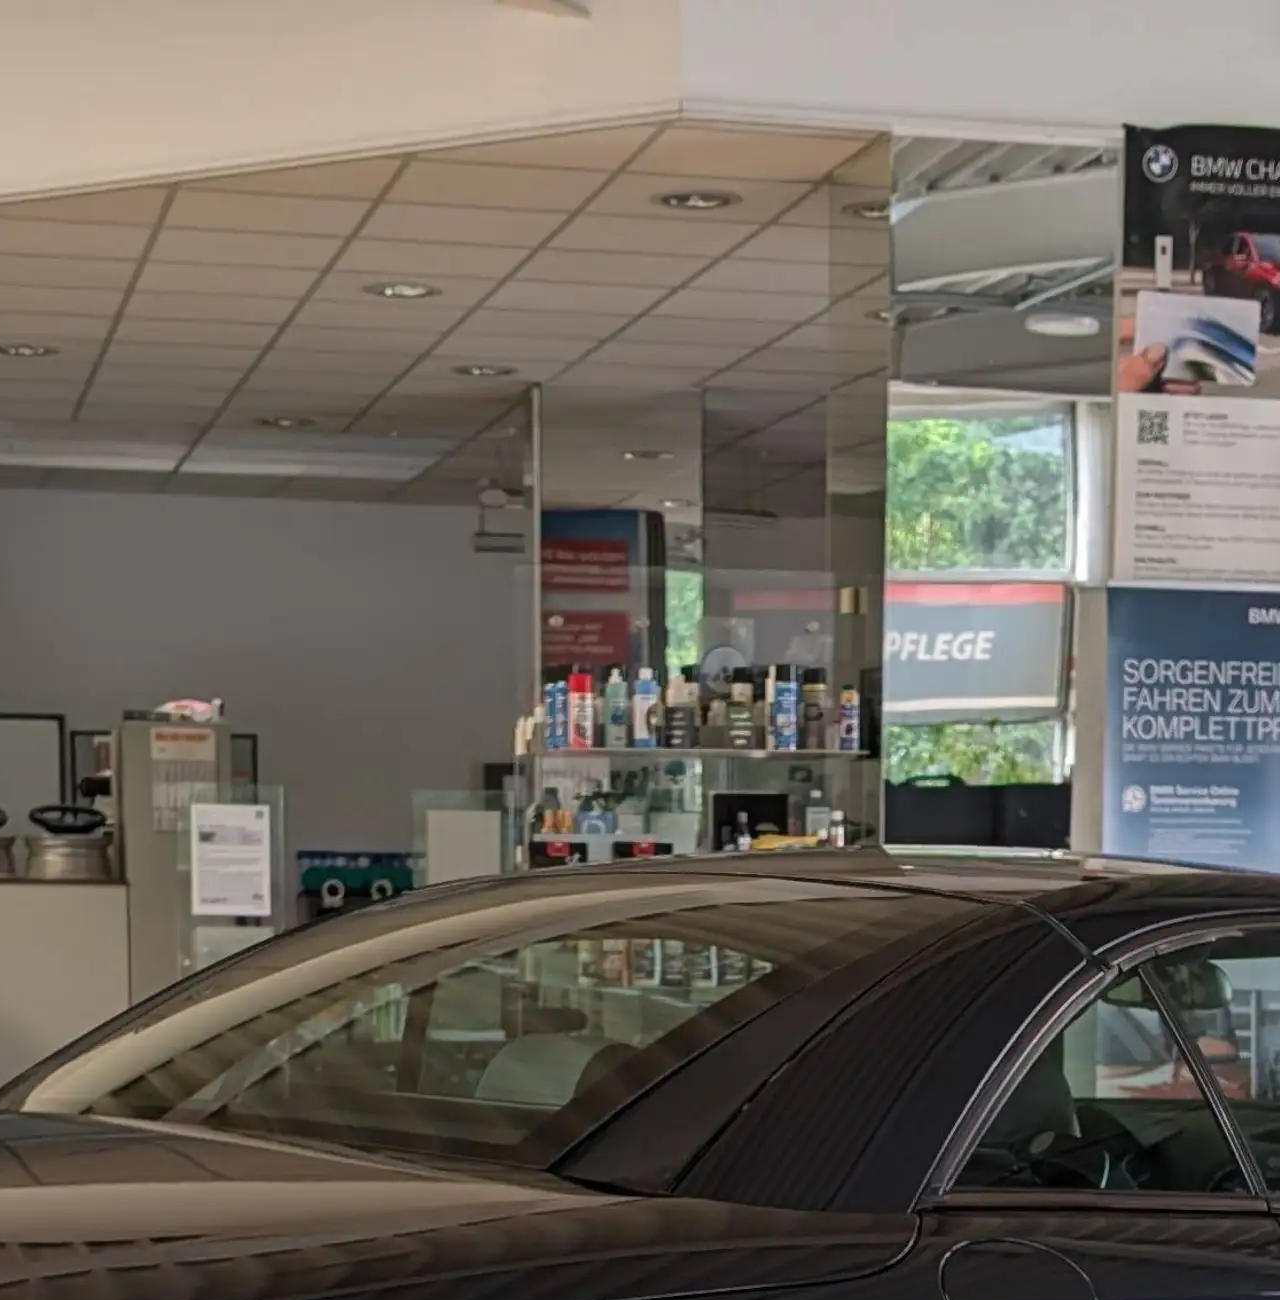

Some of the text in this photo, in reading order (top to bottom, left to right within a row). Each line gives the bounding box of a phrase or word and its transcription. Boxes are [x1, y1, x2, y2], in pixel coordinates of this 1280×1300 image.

[1190, 154, 1243, 180] BMW
[882, 630, 995, 662] PFLEGE
[1122, 687, 1222, 714] FAHREN
